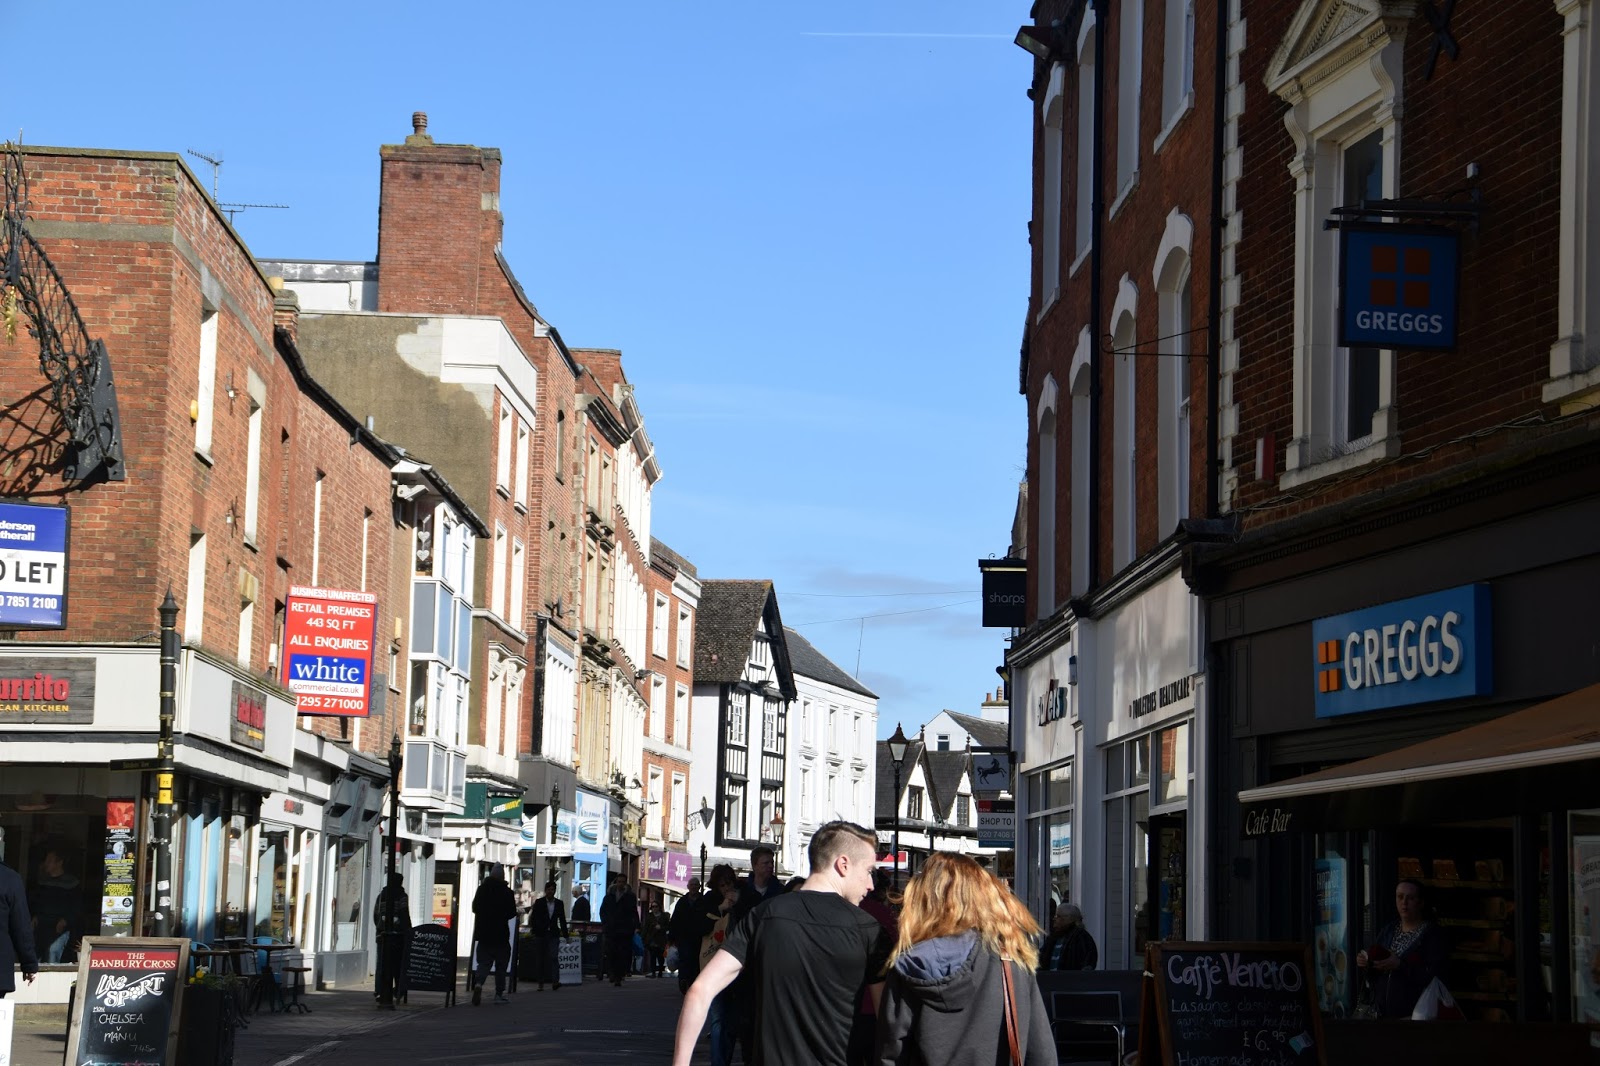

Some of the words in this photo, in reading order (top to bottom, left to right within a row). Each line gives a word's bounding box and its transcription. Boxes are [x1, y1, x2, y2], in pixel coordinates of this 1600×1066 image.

[1356, 310, 1443, 334] GREGGS
[15, 561, 57, 584] LET
[291, 586, 328, 598] BUSINESS
[328, 590, 375, 602] UNAFFECTED
[990, 591, 1025, 606] sharps
[6, 596, 30, 608] 7851
[32, 597, 58, 609] 2100
[292, 602, 325, 614] RETAIL
[327, 605, 371, 618] PREMISES
[306, 618, 324, 628] 443
[326, 619, 340, 630] SQ
[342, 620, 356, 630] FT
[290, 635, 312, 646] ALL
[314, 636, 369, 650] ENQUIRIES
[1344, 610, 1464, 690] GREGGS
[295, 657, 360, 682] white
[323, 698, 364, 710] 271000
[491, 799, 522, 815] SUBWAY
[980, 817, 1001, 826] SHOP
[1002, 817, 1012, 826] TO
[1269, 808, 1293, 833] Bar
[127, 952, 145, 960] THE
[90, 959, 142, 968] BANBURY
[143, 960, 176, 969] CROSS
[98, 1012, 145, 1024] CHELSEA
